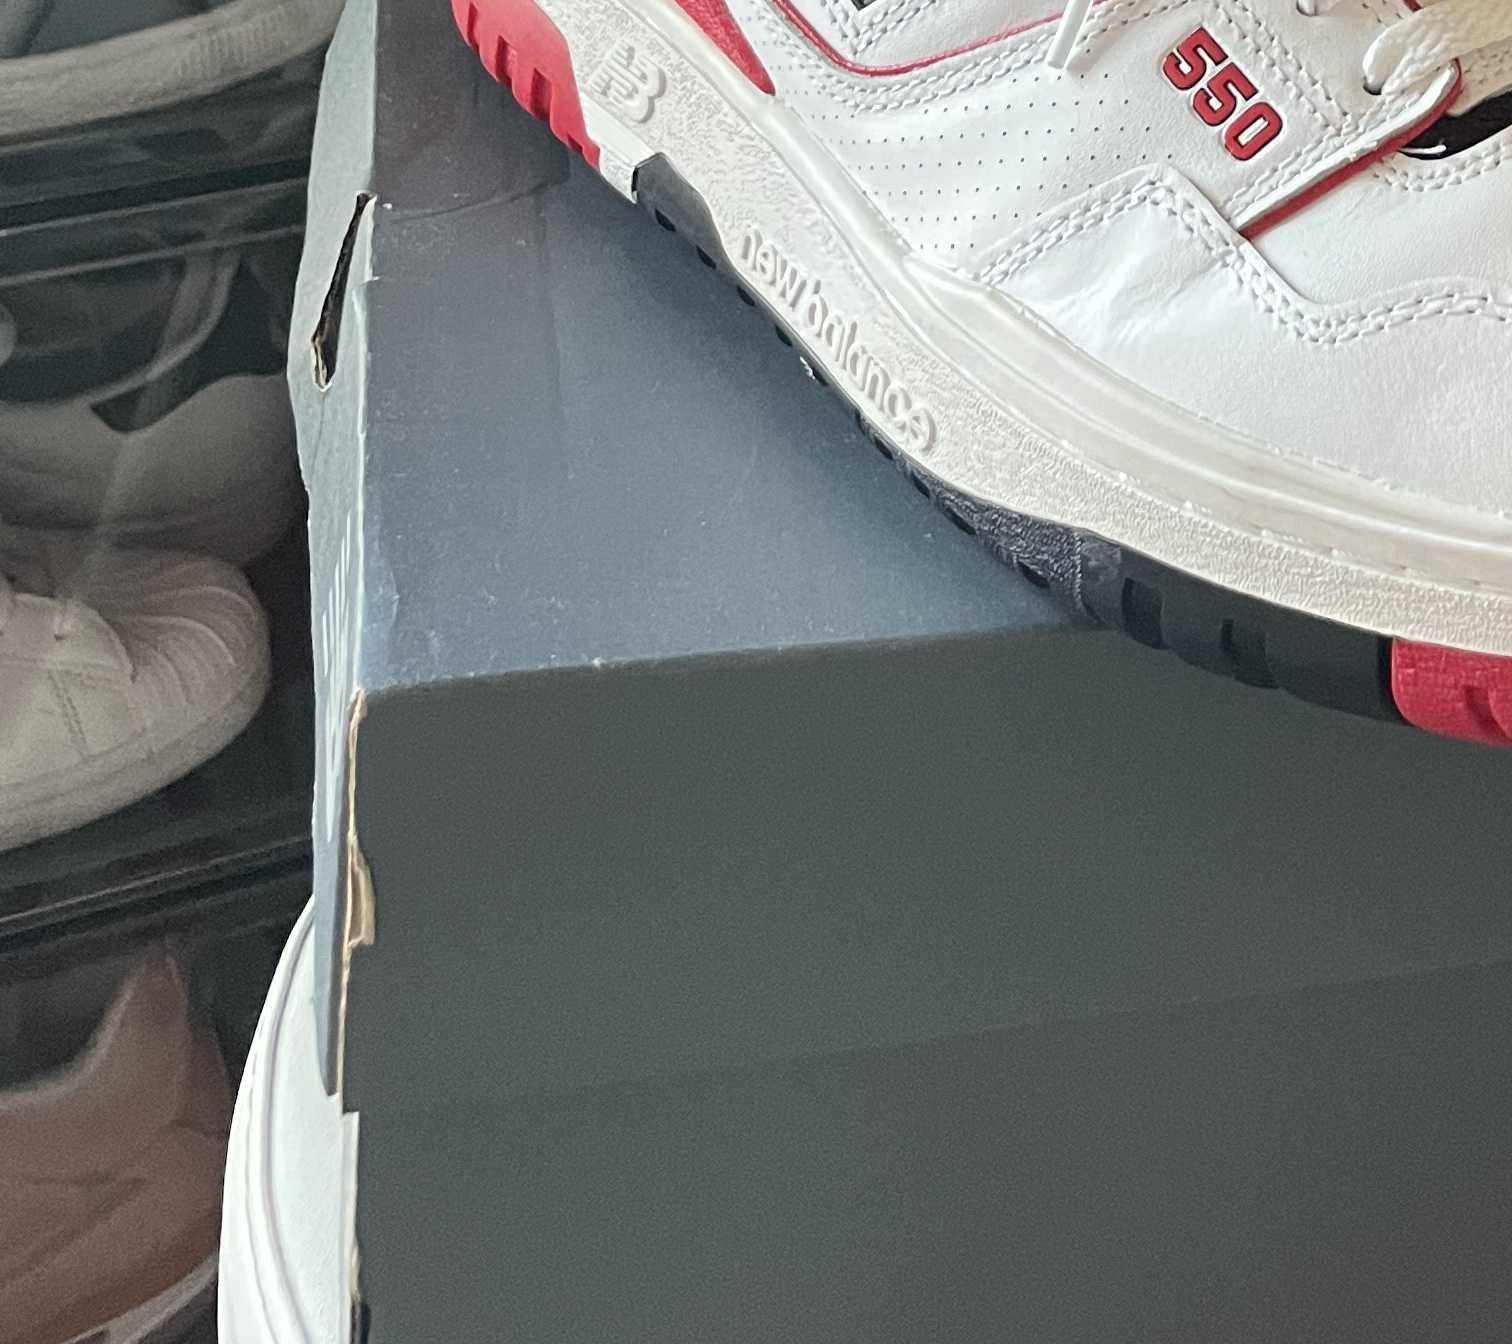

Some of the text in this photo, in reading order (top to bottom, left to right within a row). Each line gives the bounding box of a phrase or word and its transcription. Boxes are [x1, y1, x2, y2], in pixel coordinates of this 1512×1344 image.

[1163, 26, 1283, 162] 550
[741, 227, 938, 453] new balance
